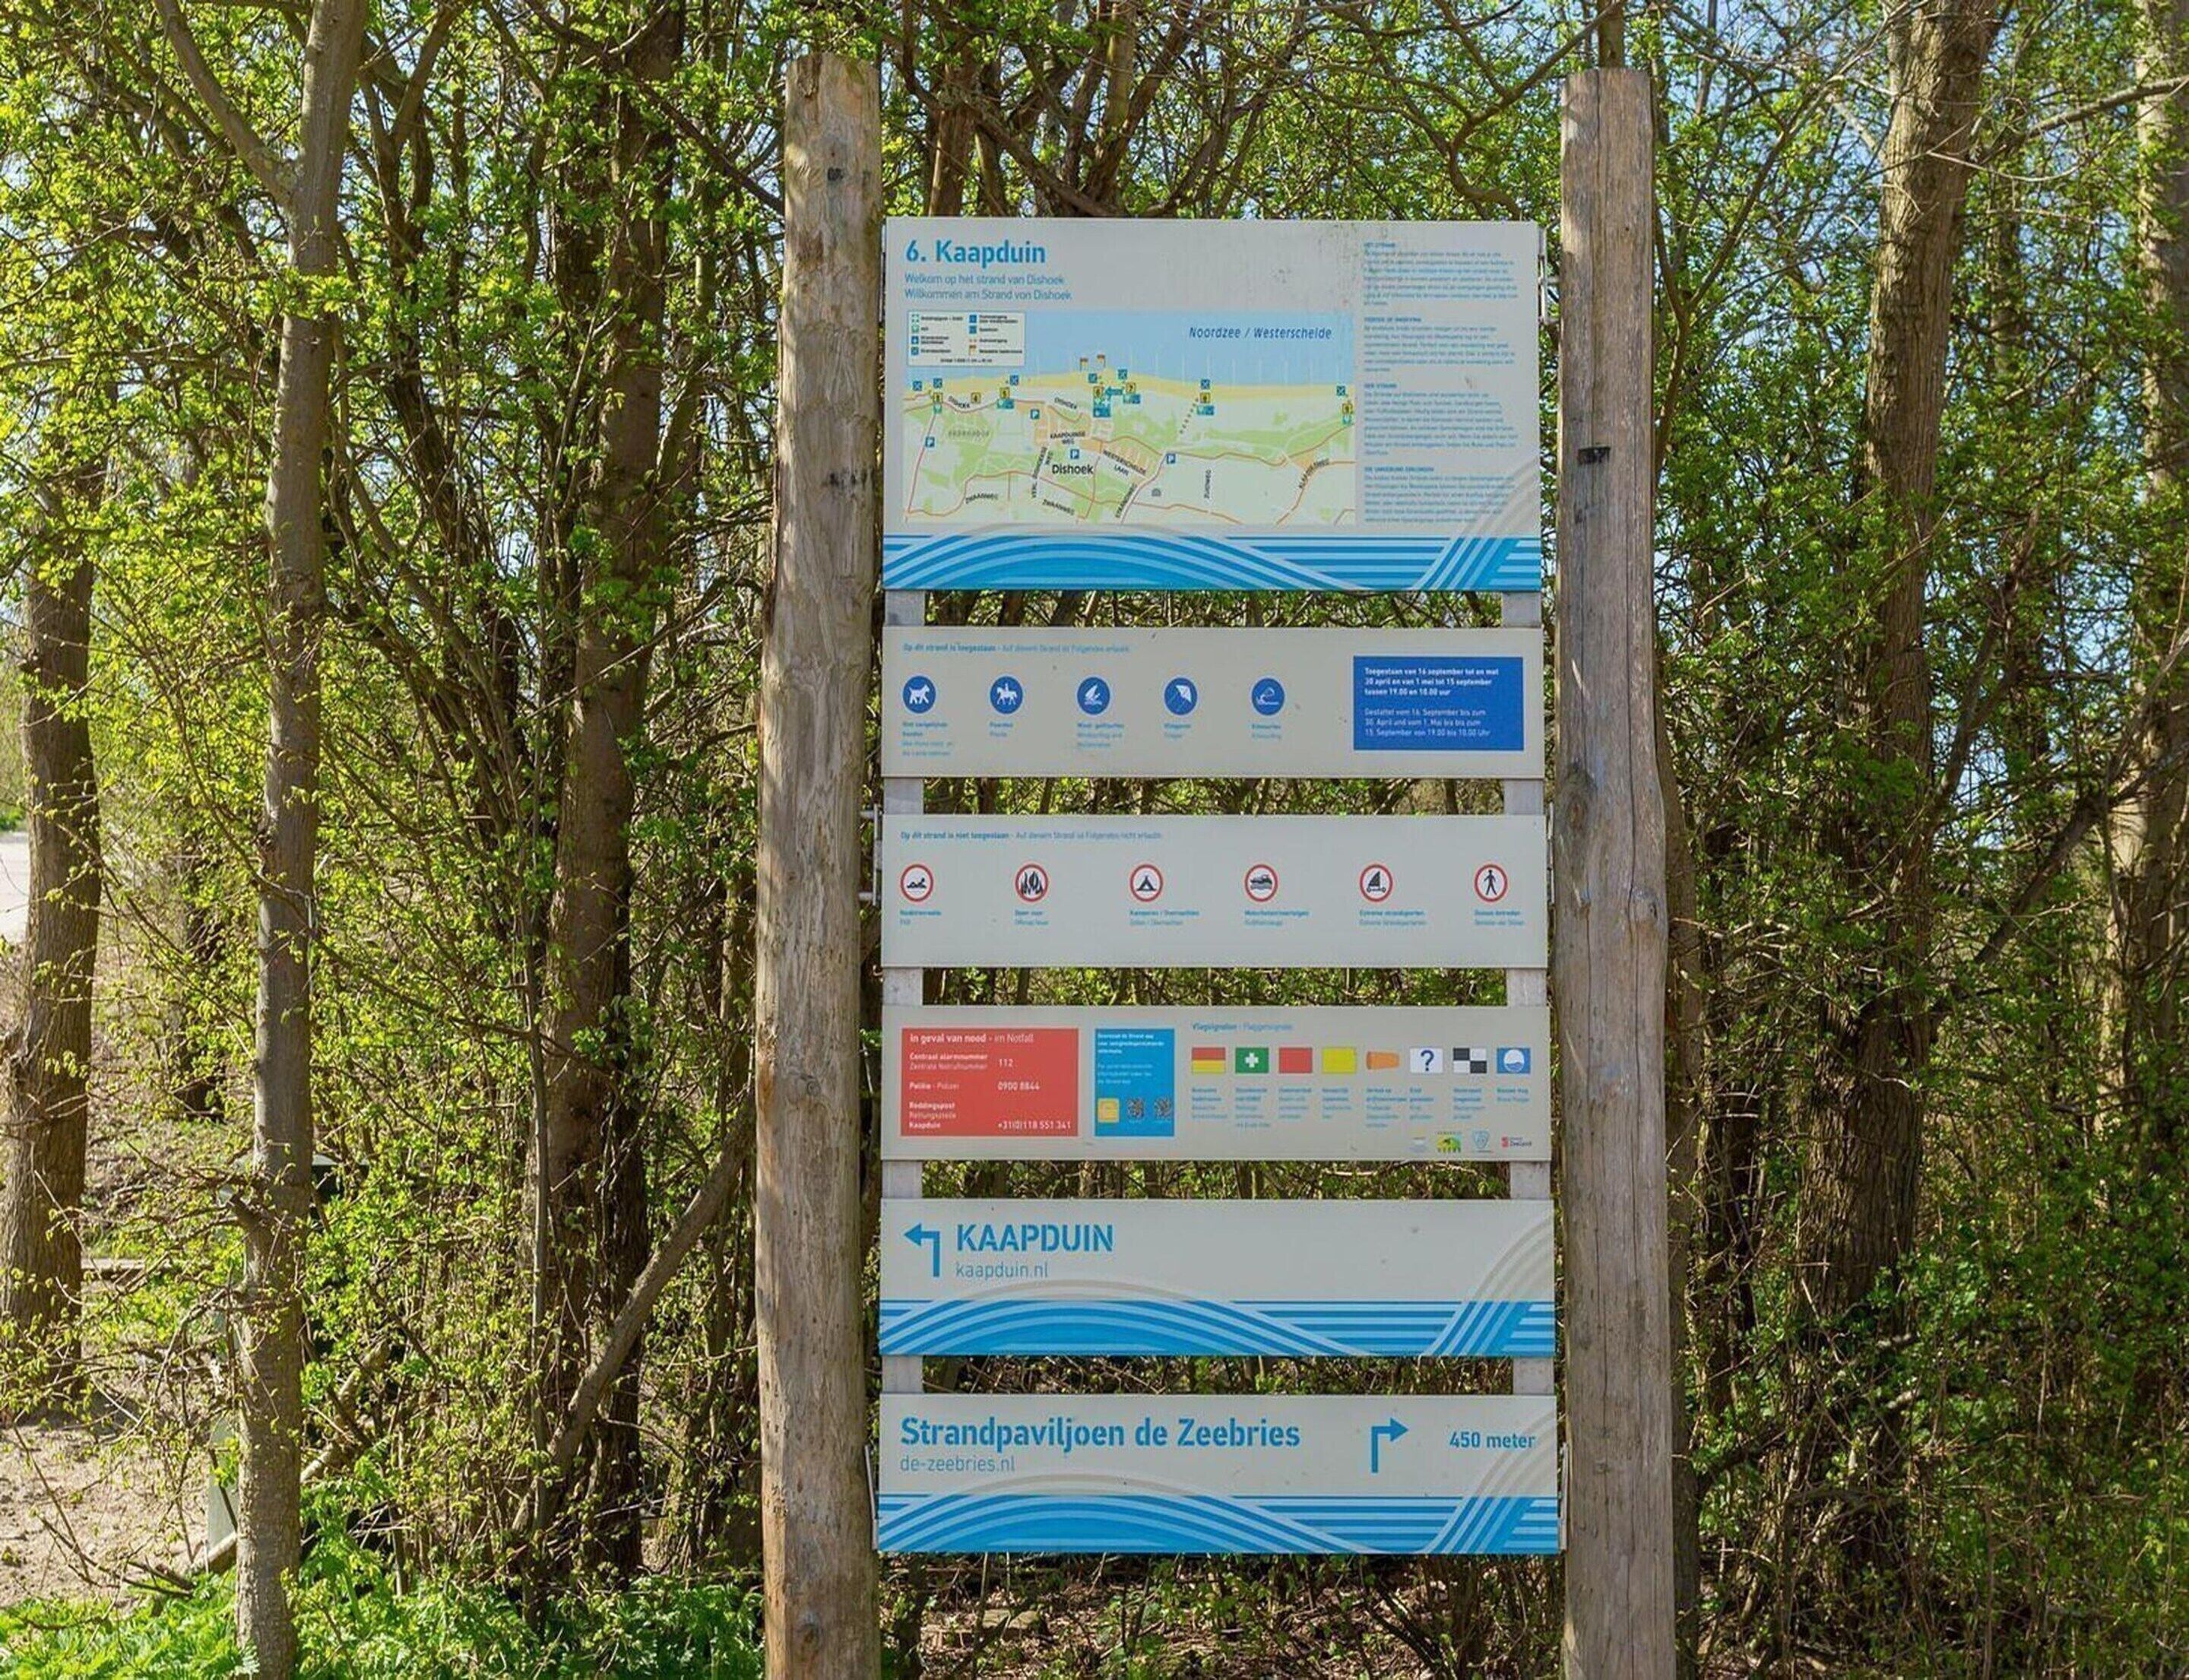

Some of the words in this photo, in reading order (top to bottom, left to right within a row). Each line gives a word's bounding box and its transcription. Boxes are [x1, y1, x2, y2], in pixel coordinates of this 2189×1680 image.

[905, 240, 927, 263] 6.
[936, 240, 1046, 268] Kaapduin
[905, 274, 942, 284] Welkom
[945, 276, 956, 286] op
[958, 274, 974, 284] het
[977, 274, 1006, 284] strand
[1027, 274, 1063, 284] Dishoek
[905, 289, 961, 300] Willkommen
[982, 289, 1012, 300] Strand
[1034, 289, 1072, 300] Dishoek
[1189, 327, 1241, 339] Noordzee
[1254, 327, 1332, 339] Westerschelde
[1052, 464, 1094, 474] Dishoek
[1365, 668, 1403, 677] Toegestaan
[921, 1033, 945, 1044] geval
[965, 1034, 987, 1043] nood
[1006, 1033, 1034, 1043] Notfall
[999, 1059, 1013, 1067] 112
[998, 1082, 1018, 1091] 0900
[957, 1224, 1114, 1252] KAAPDUIN
[955, 1262, 1048, 1280] kaapduin.nl
[901, 1416, 1125, 1453] Strandpaviljoen
[1136, 1417, 1167, 1447] de
[1177, 1417, 1301, 1447] Zeebries
[1449, 1432, 1481, 1448] 450
[1487, 1434, 1536, 1449] meter
[901, 1456, 1015, 1472] de-zeebries.nl
